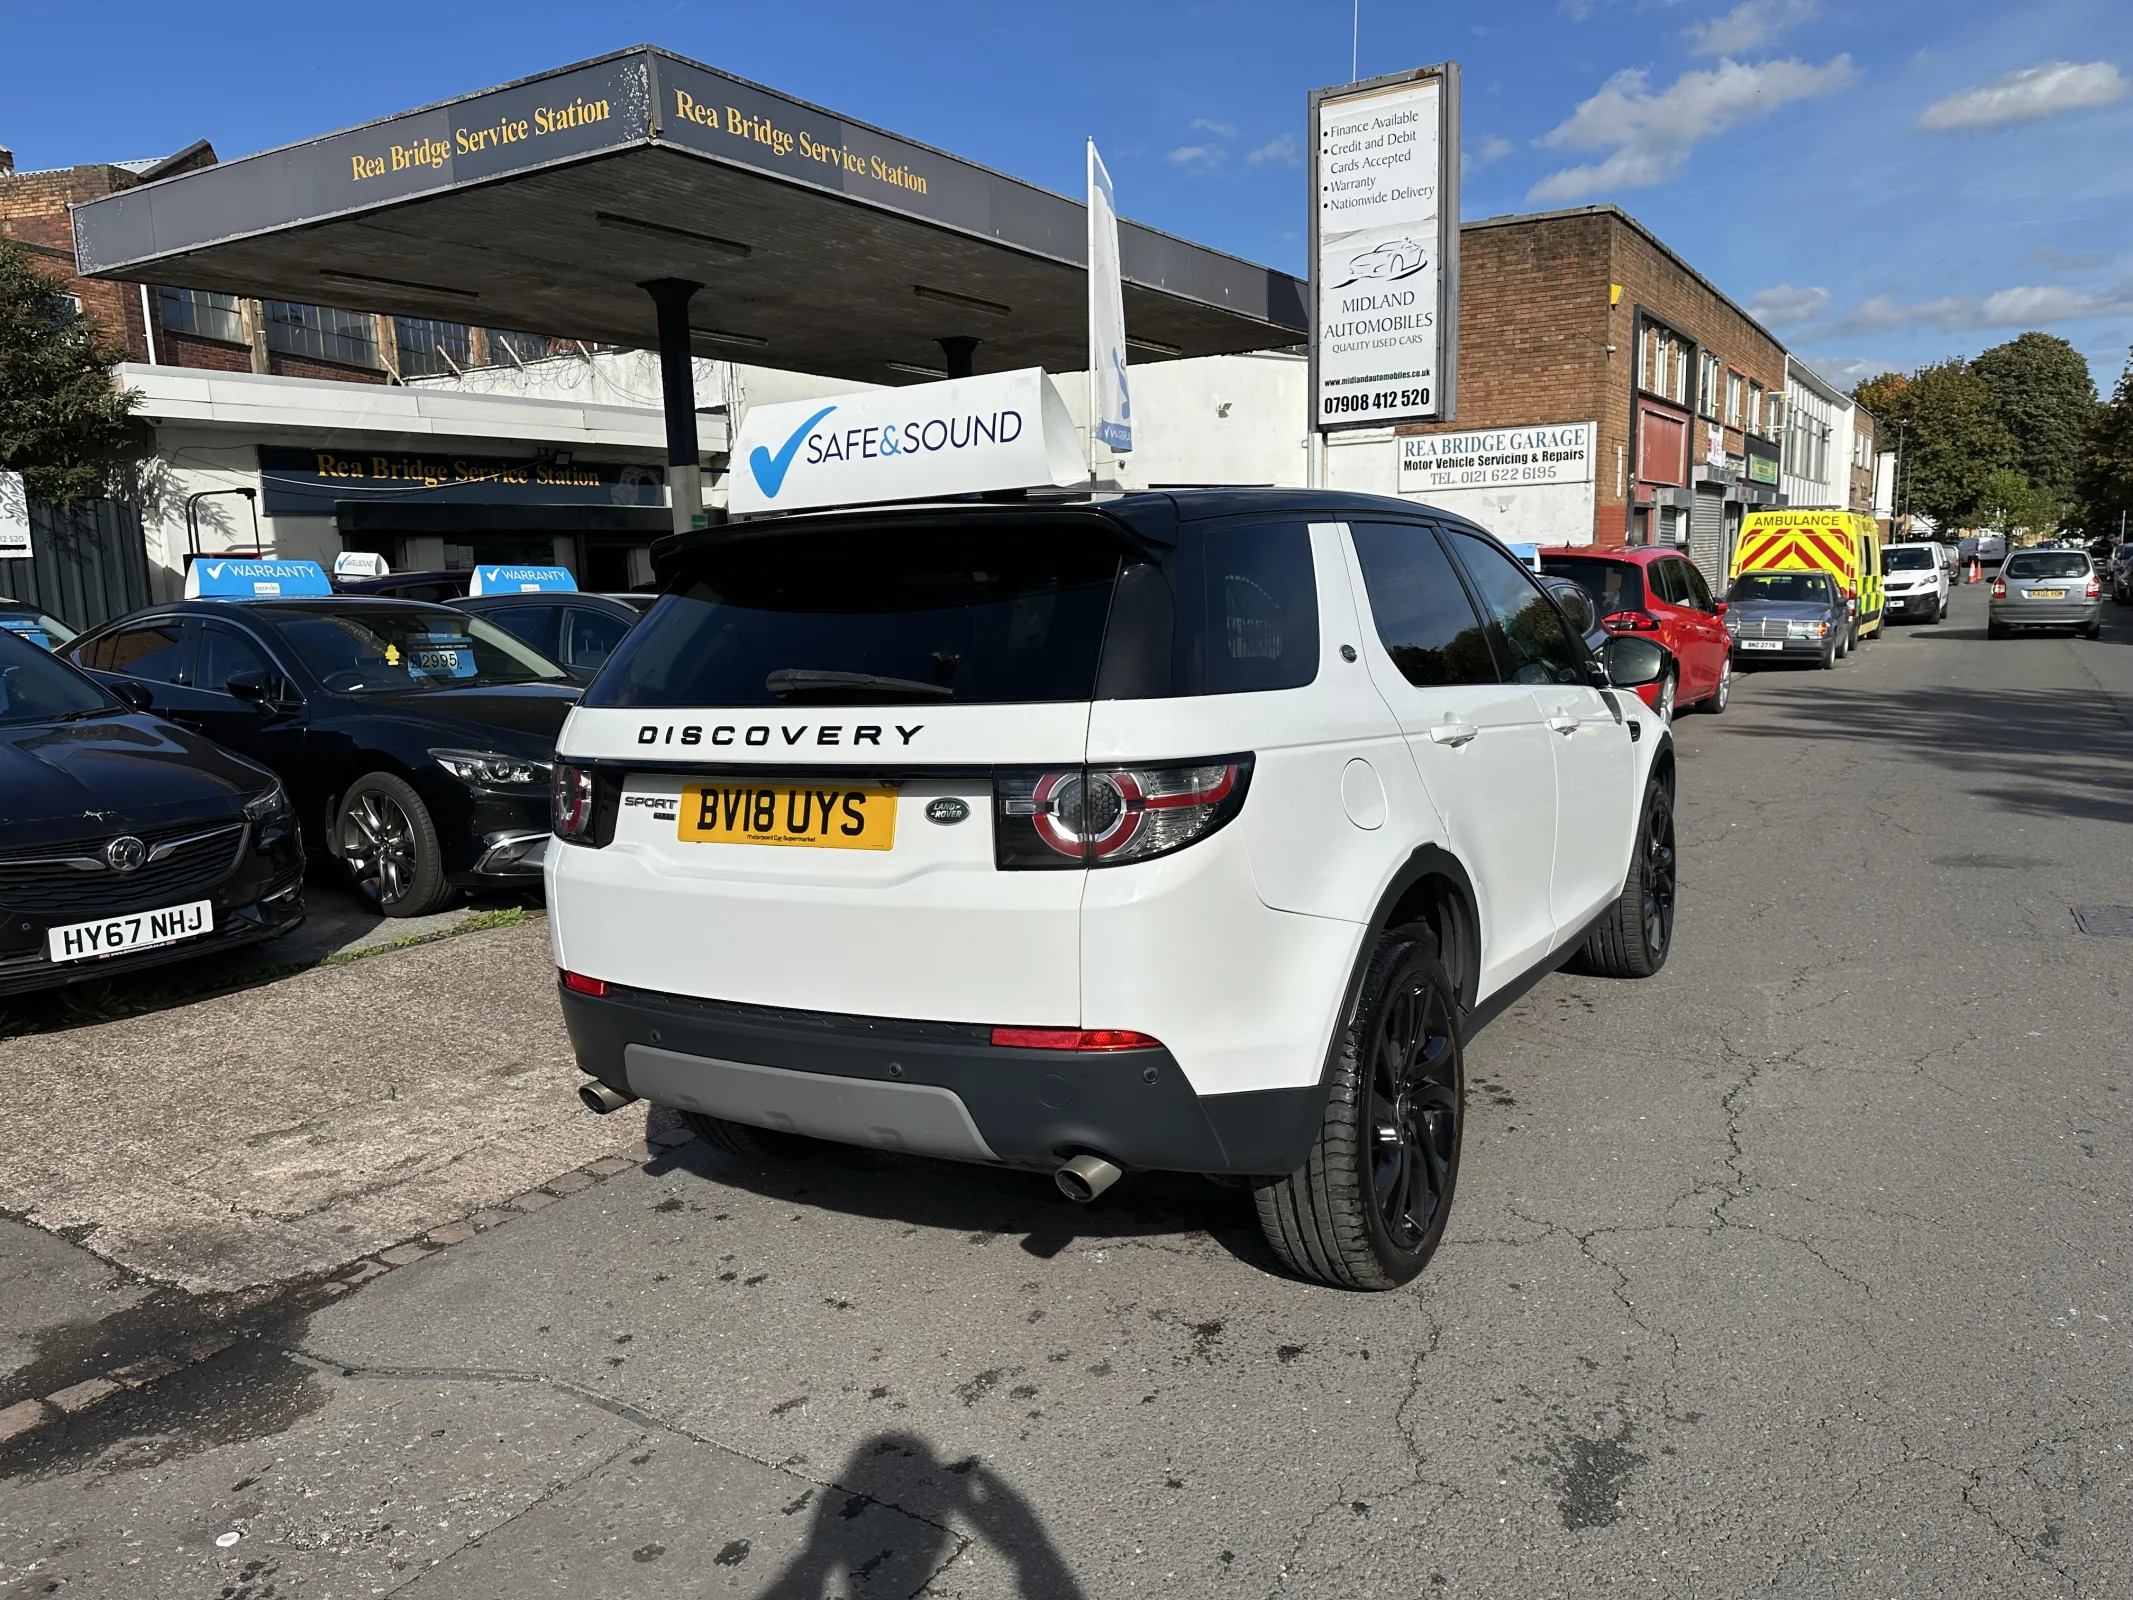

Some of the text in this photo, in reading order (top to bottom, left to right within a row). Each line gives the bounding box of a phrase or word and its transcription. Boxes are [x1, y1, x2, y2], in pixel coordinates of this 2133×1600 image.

[1330, 110, 1419, 138] Finance Available
[351, 97, 610, 181] Rea Bridge Service Station
[674, 89, 927, 194] Rea Bridge Service Station
[1331, 130, 1417, 156] Credit and Debit
[1331, 149, 1411, 174] Cards Accepted
[1331, 176, 1376, 193] Warranty
[1331, 185, 1435, 211] Nationwide Delivery
[1342, 291, 1415, 313] MIDLAND
[1324, 312, 1433, 339] AUTOMOBILES
[1332, 334, 1423, 353] QUALITY USED CARS
[1324, 368, 1430, 387] www.midlandautomobiles.co.uk
[1324, 388, 1430, 414] 07908 412 520
[1404, 428, 1585, 457] REA BRIDGE GARAGE
[317, 454, 600, 487] Rea Bridge Service Station
[1404, 449, 1584, 471] Motor Vehicle Servicing & Repairs
[1431, 465, 1557, 485] TEL. 0121 622 6195
[1754, 515, 1840, 526] AMBULANCE
[228, 564, 314, 578] WARRANTY
[501, 570, 565, 580] WARRANTY
[637, 725, 925, 746] DISCOVERY
[625, 796, 678, 809] SPORT
[697, 788, 867, 836] BV18 UYS
[934, 810, 962, 818] ROVER
[64, 918, 141, 955] HY67
[151, 906, 203, 939] NHJ
